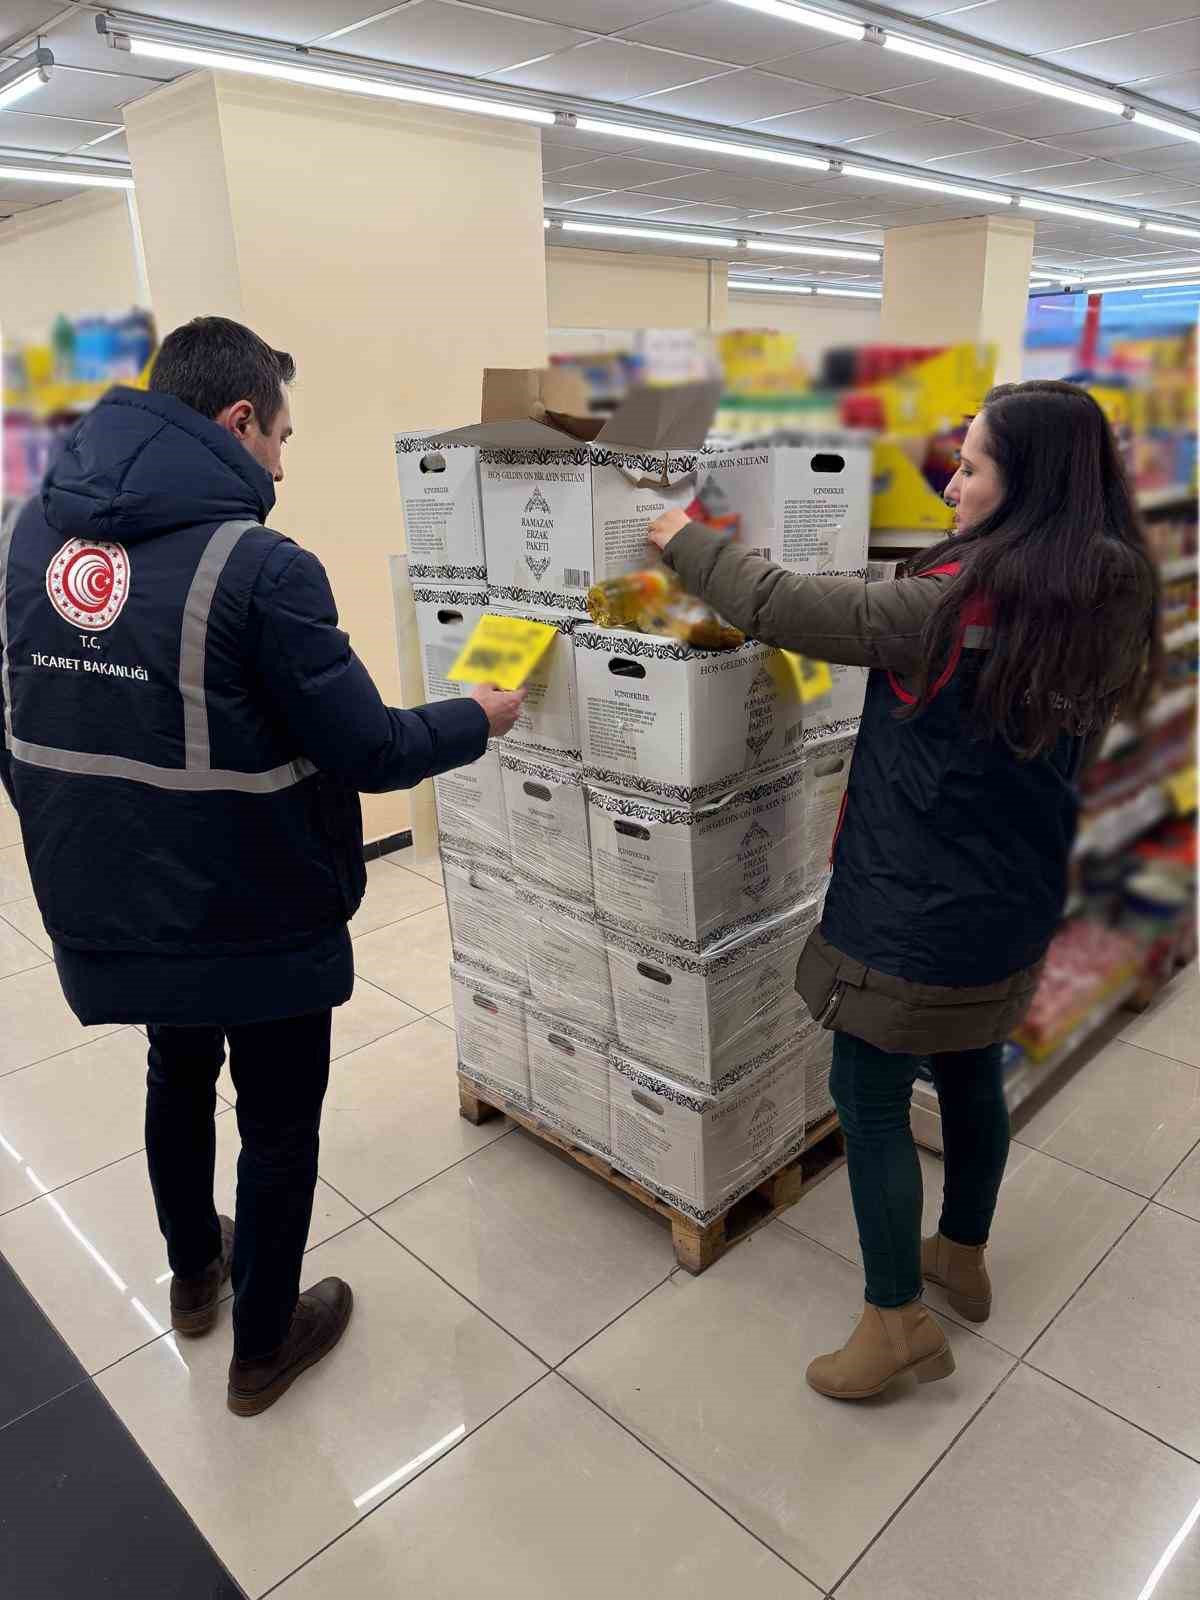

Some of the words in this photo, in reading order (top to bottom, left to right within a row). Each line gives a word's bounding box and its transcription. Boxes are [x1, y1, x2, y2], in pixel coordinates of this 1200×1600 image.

[736, 455, 769, 466] SULTANI
[523, 471, 534, 480] ON
[521, 517, 554, 529] RAMAZAN
[526, 529, 549, 540] ERZAK
[79, 635, 101, 650] T.C.
[31, 651, 81, 671] TİCARET
[83, 659, 149, 681] BAKANLIĞI
